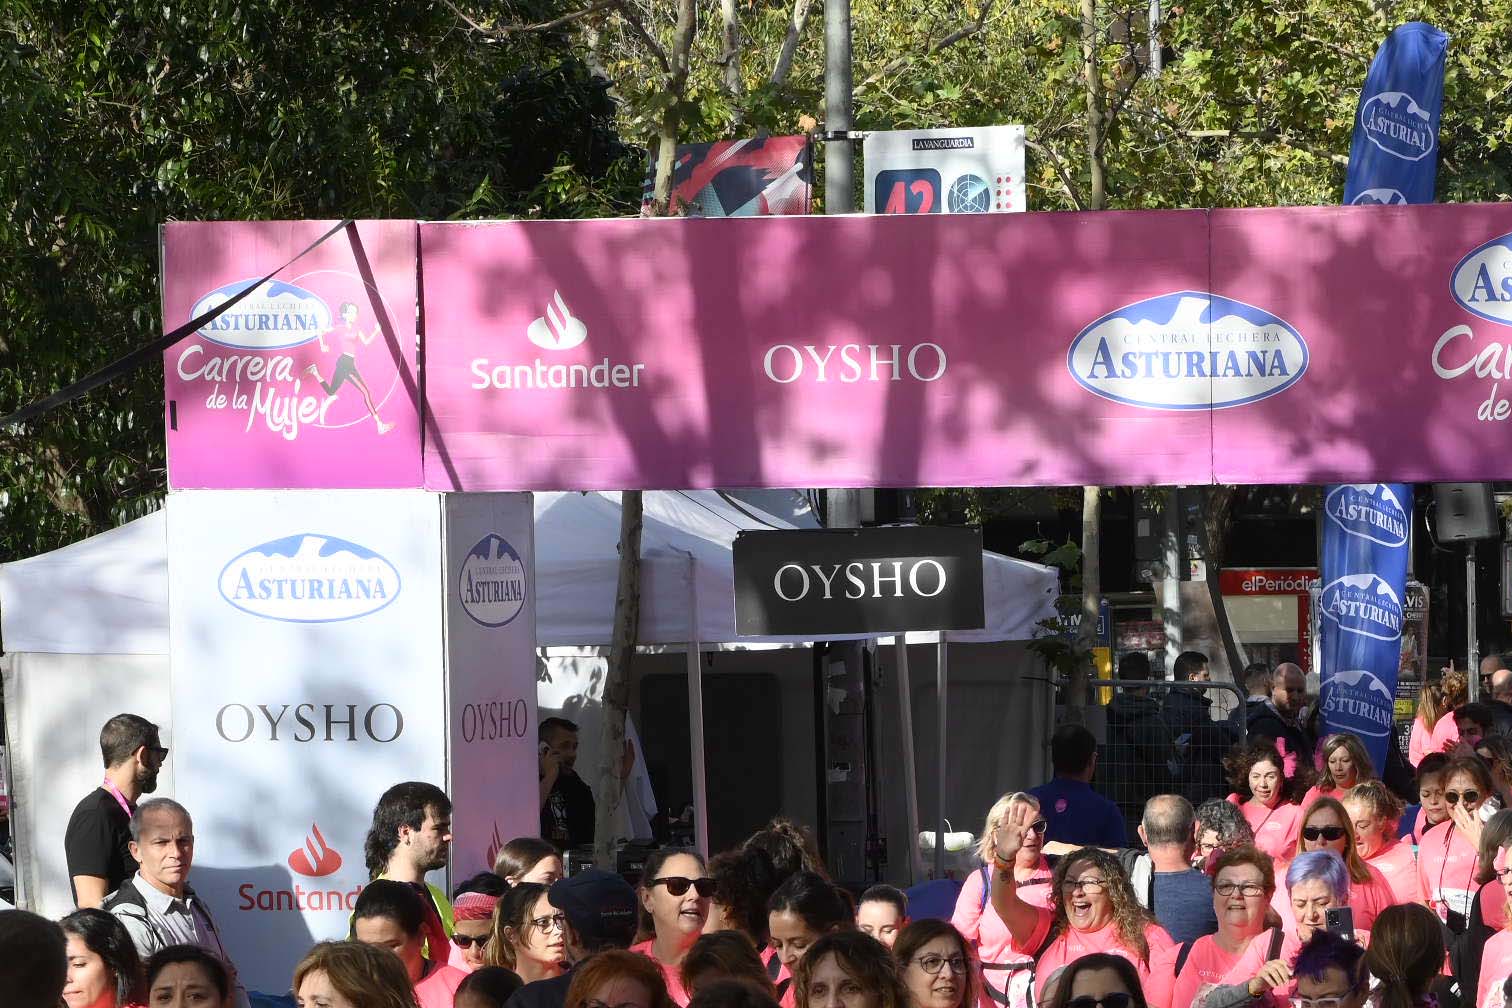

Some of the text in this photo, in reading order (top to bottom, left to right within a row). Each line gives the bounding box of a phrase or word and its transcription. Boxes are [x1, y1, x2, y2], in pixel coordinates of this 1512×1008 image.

[202, 304, 319, 331] ASTURIANA
[177, 344, 295, 382] Carrera
[470, 355, 645, 390] Santander
[763, 342, 947, 383] OYSHO
[1087, 341, 1290, 379] ASTURIANA
[206, 378, 339, 440] de la Mujer
[1477, 383, 1511, 421] de
[1334, 494, 1405, 539] ASTURIANA
[233, 567, 387, 601] ASTURIANA
[465, 569, 523, 604] ASTURIANA
[774, 558, 947, 603] OYSHO
[216, 702, 404, 743] OYSHO
[462, 698, 528, 743] OYSHO
